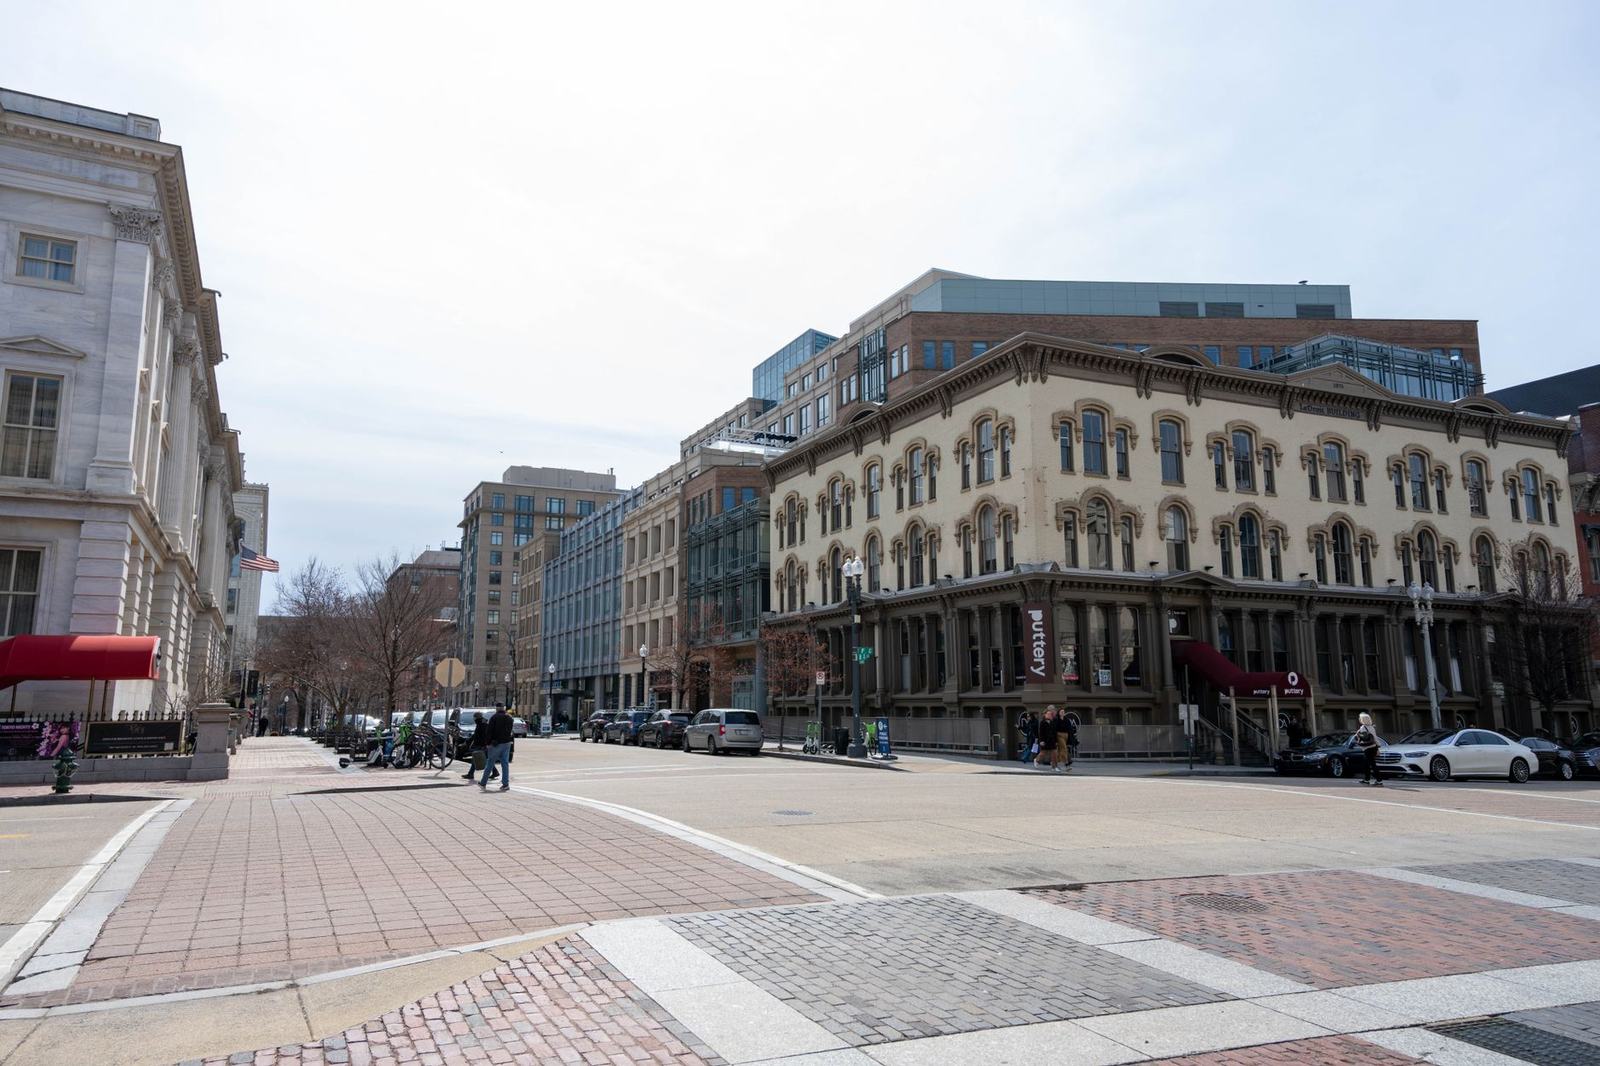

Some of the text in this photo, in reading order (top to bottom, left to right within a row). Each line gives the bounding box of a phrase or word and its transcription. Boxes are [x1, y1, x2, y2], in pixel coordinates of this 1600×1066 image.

[1327, 406, 1360, 419] BUILDING
[1028, 609, 1046, 677] puttery
[1284, 688, 1304, 696] puttery
